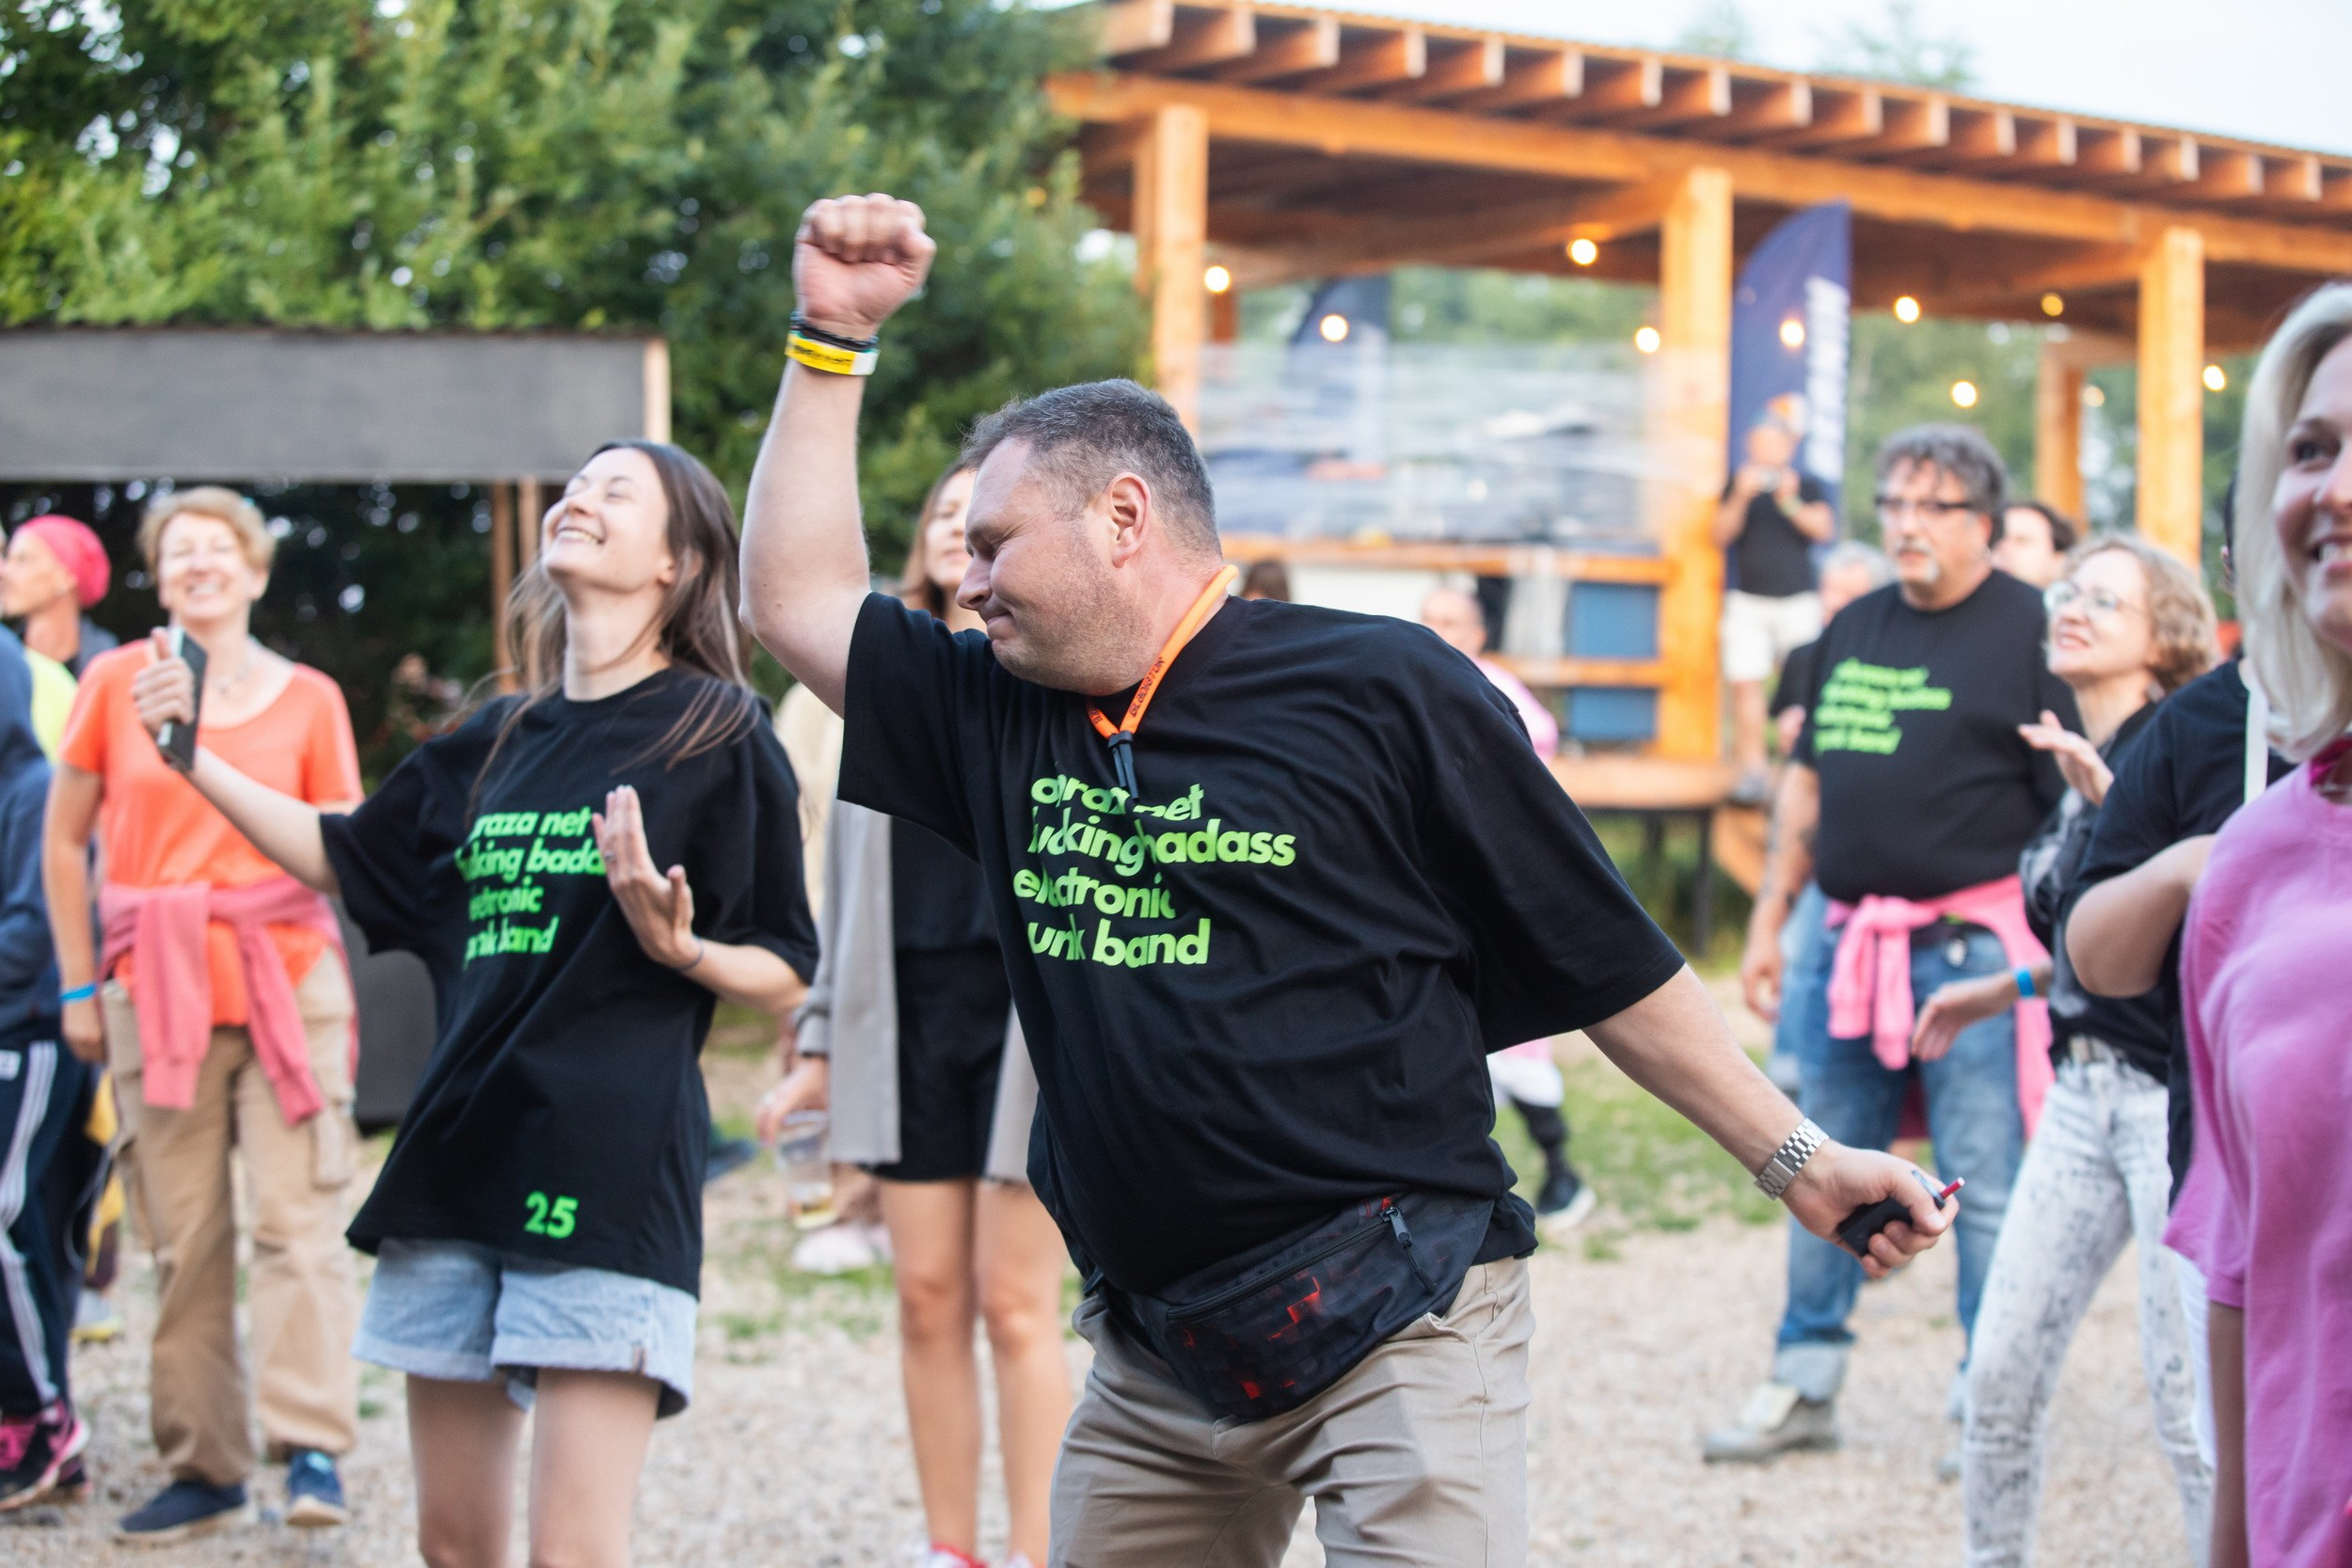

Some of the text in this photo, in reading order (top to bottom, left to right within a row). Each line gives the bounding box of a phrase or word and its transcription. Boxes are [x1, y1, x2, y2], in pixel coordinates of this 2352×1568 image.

[467, 806, 592, 843] raza net
[1027, 806, 1146, 877] cking
[525, 836, 606, 876] bada
[1027, 913, 1211, 968] unk band
[524, 1190, 579, 1239] 25
